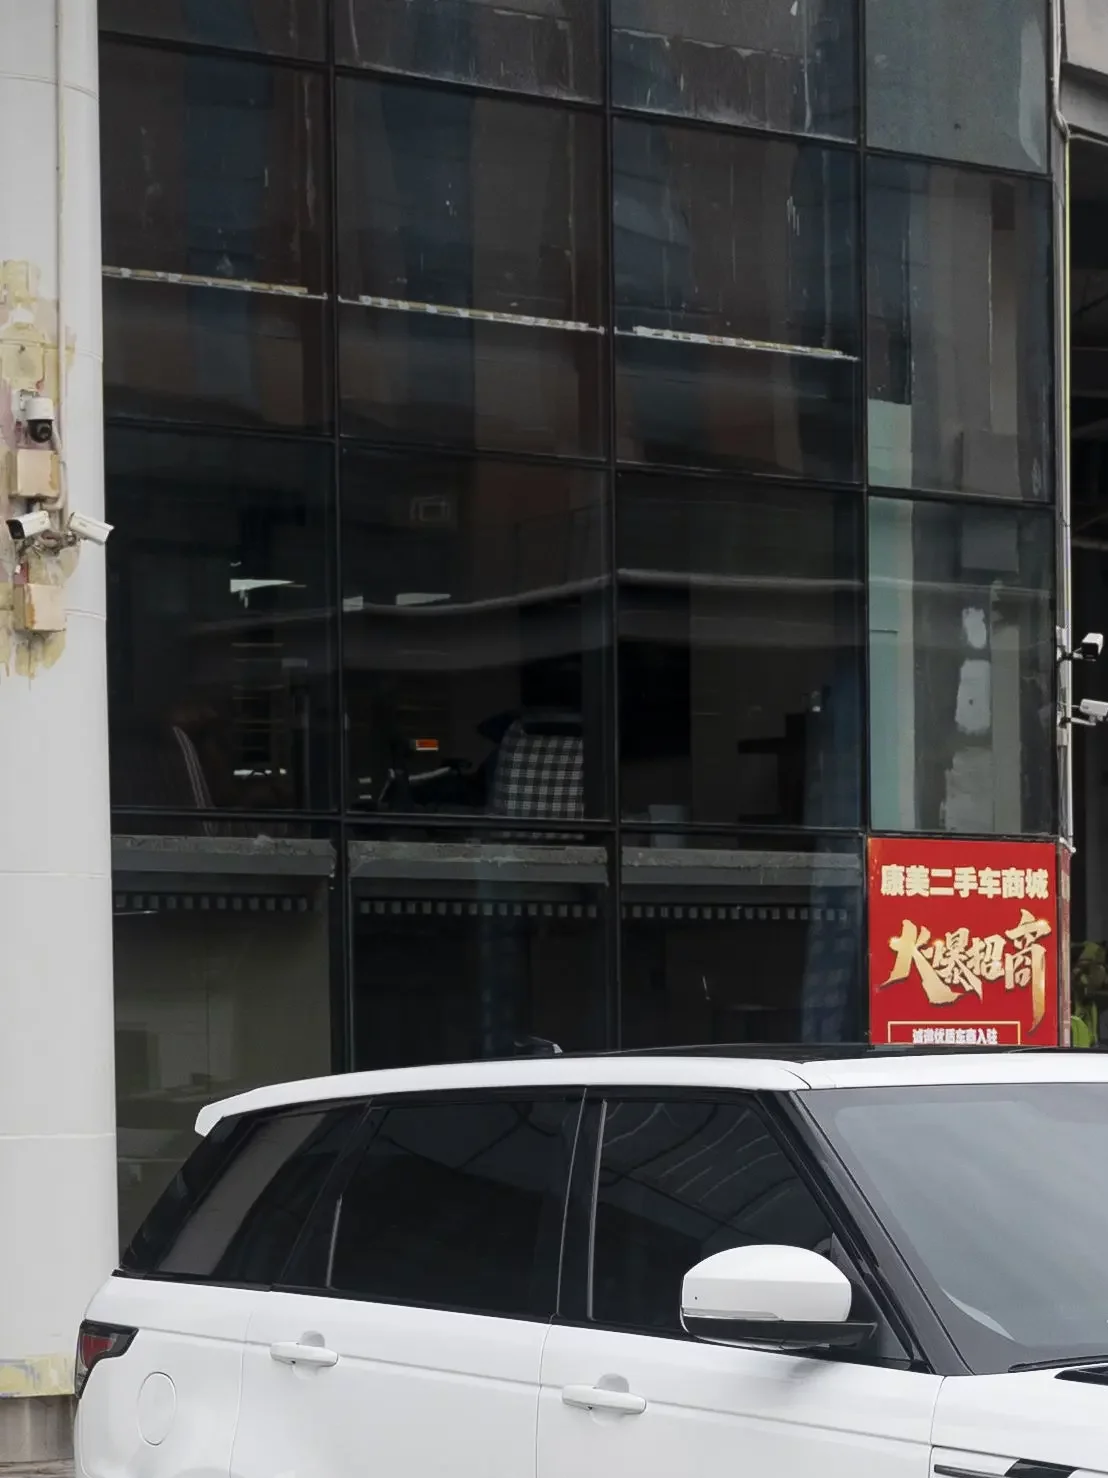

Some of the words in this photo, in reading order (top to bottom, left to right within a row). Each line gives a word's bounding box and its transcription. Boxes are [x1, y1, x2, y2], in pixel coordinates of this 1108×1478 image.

[880, 864, 1049, 899] 康美二手车商城
[878, 908, 1052, 1035] 火爆招商
